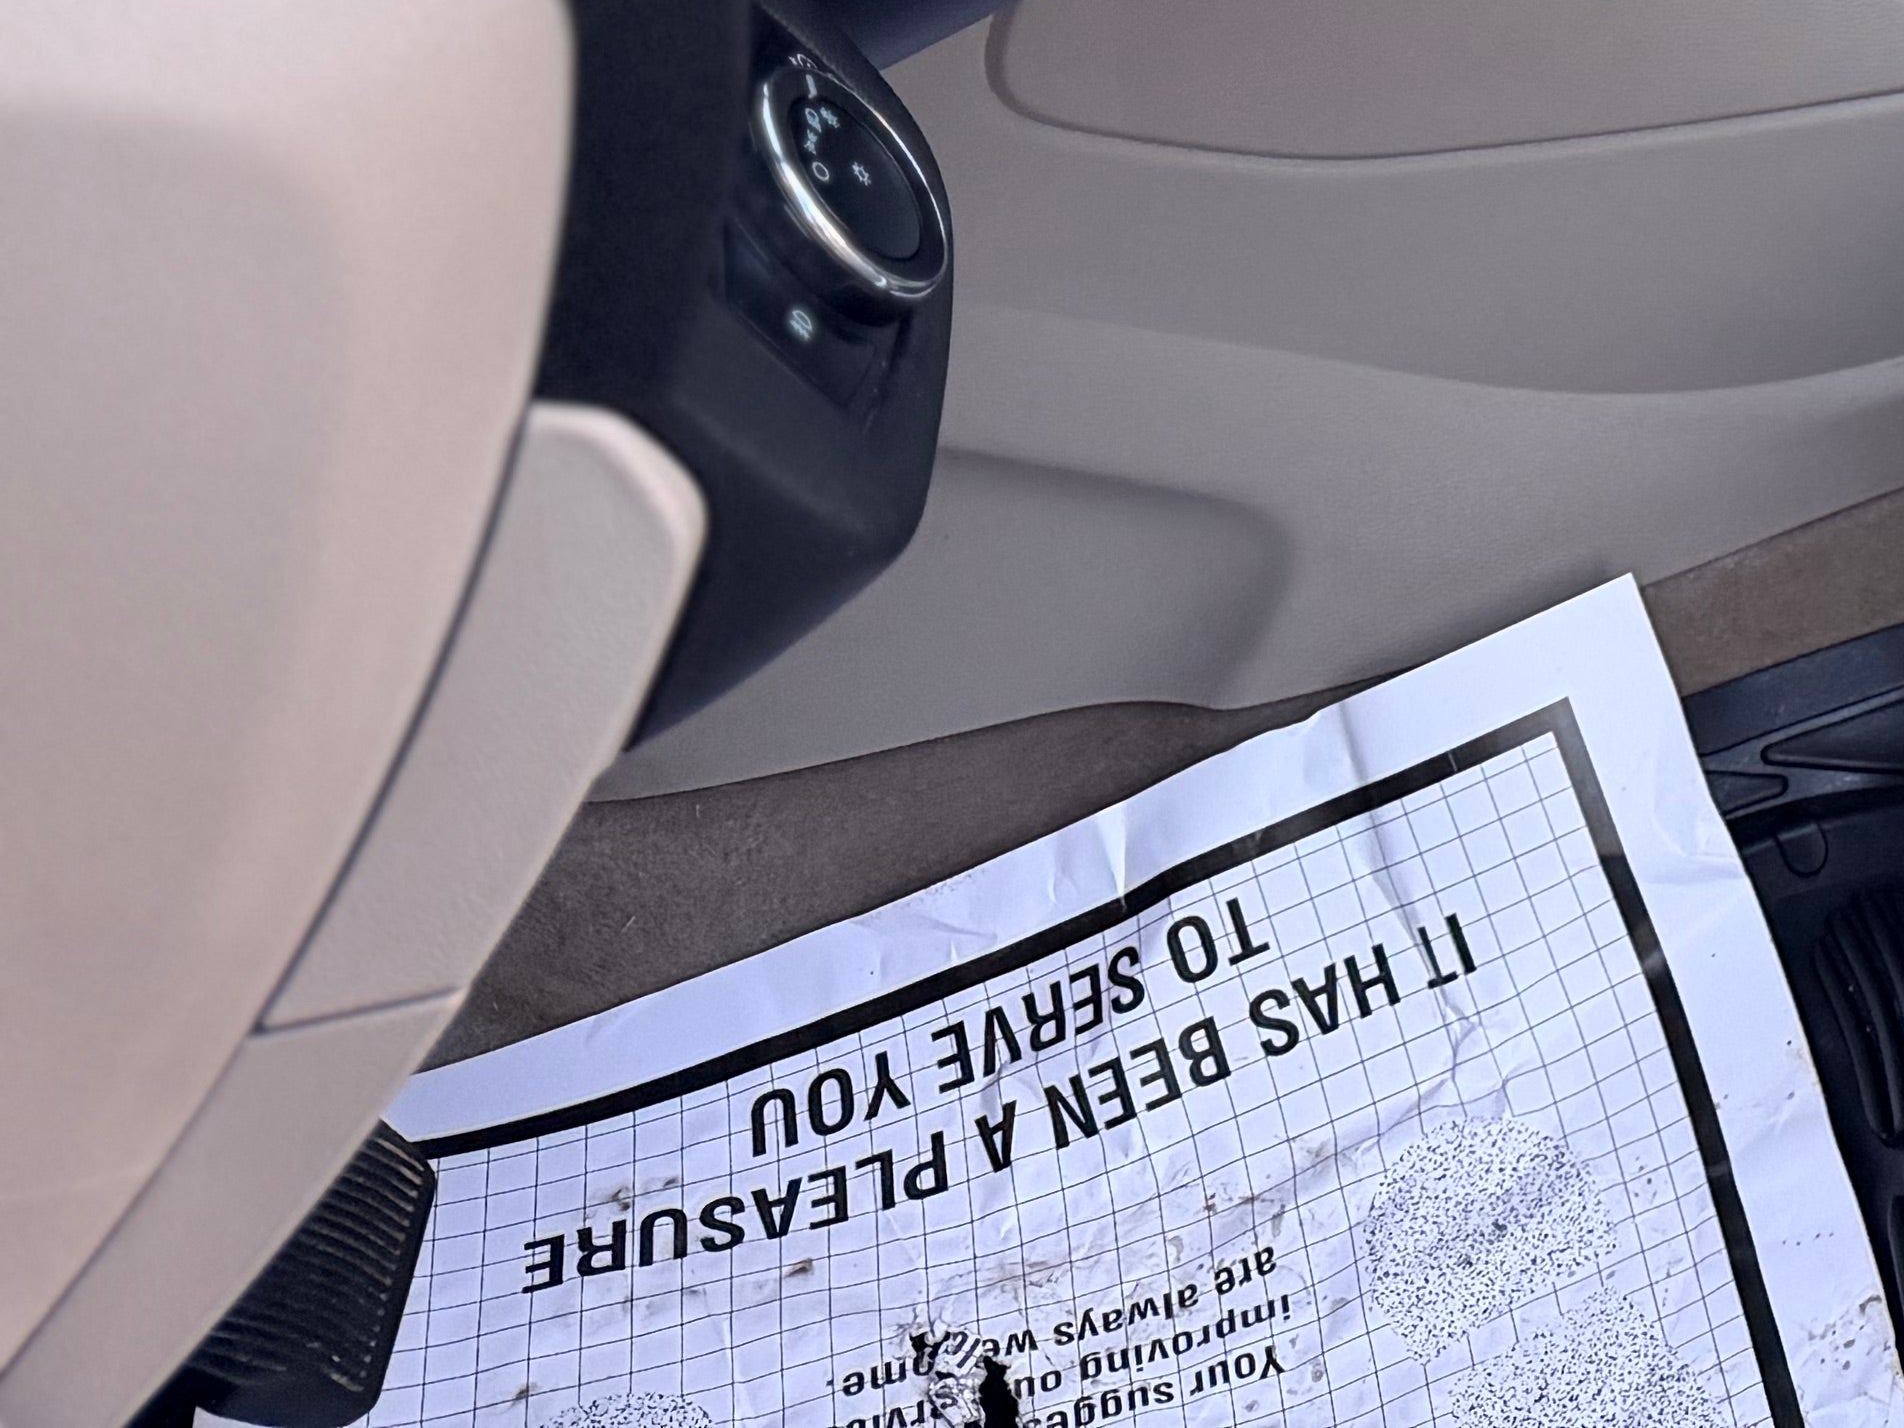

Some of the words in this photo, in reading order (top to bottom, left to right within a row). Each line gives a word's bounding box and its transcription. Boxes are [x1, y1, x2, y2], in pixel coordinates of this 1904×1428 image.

[1165, 897, 1269, 983] TO
[1416, 912, 1476, 988] IT
[930, 945, 1144, 1094] SERVE
[1248, 942, 1399, 1056] HAS
[749, 1049, 909, 1156] YOU
[1042, 1015, 1230, 1149] BEEN
[973, 1099, 1017, 1172] A
[521, 1130, 948, 1293] PLEASURE
[1212, 1245, 1276, 1296] are
[1053, 1283, 1198, 1346] always
[1077, 1293, 1290, 1382] improving
[1012, 1369, 1062, 1398] ou
[1188, 1342, 1285, 1398] Your
